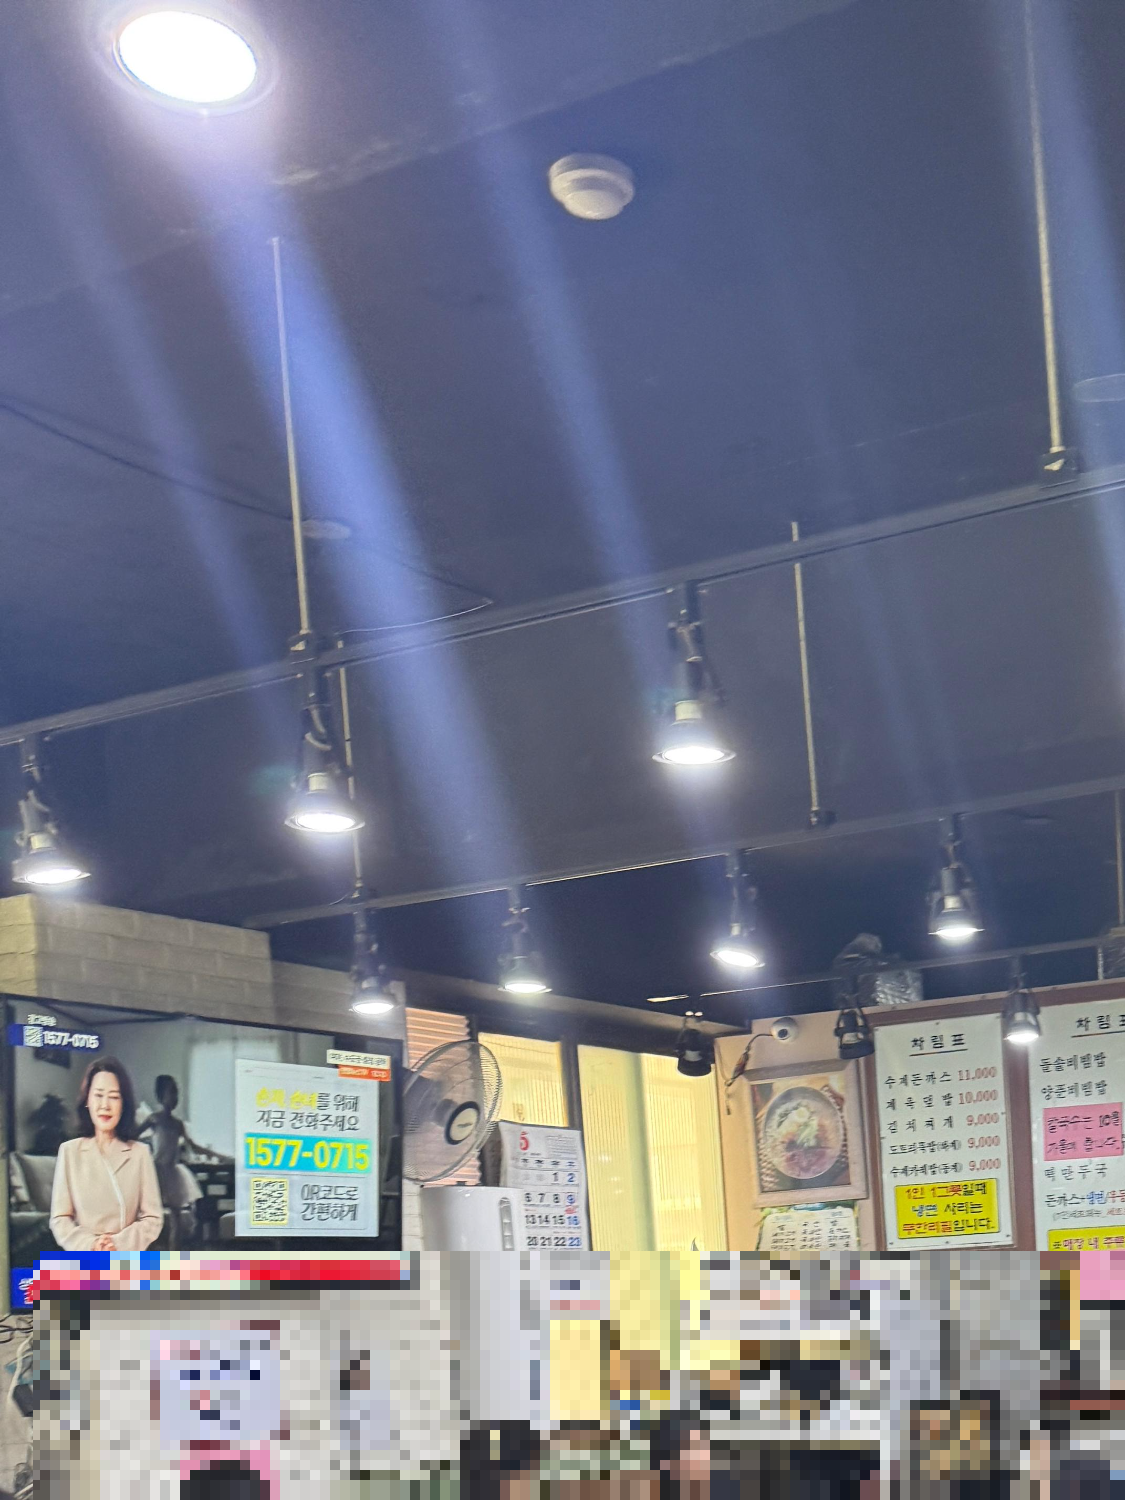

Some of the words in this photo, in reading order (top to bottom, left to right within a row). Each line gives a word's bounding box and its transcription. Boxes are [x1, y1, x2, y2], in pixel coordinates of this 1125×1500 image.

[911, 1033, 965, 1051] 차림표
[958, 1066, 997, 1081] 11,000
[333, 1094, 360, 1112] 위해
[958, 1089, 998, 1105] 10,000
[256, 1110, 286, 1129] 지금
[289, 1112, 360, 1132] 전화주세요
[966, 1113, 999, 1127] 9,000
[519, 1131, 529, 1151] 5
[968, 1136, 1000, 1149] 9,000
[246, 1137, 369, 1170] 1577-0715
[969, 1158, 1001, 1172] 9,000
[553, 1172, 558, 1182] 1
[567, 1173, 576, 1182] 2
[301, 1202, 358, 1221] 간편하게
[912, 1204, 938, 1218] 냉면
